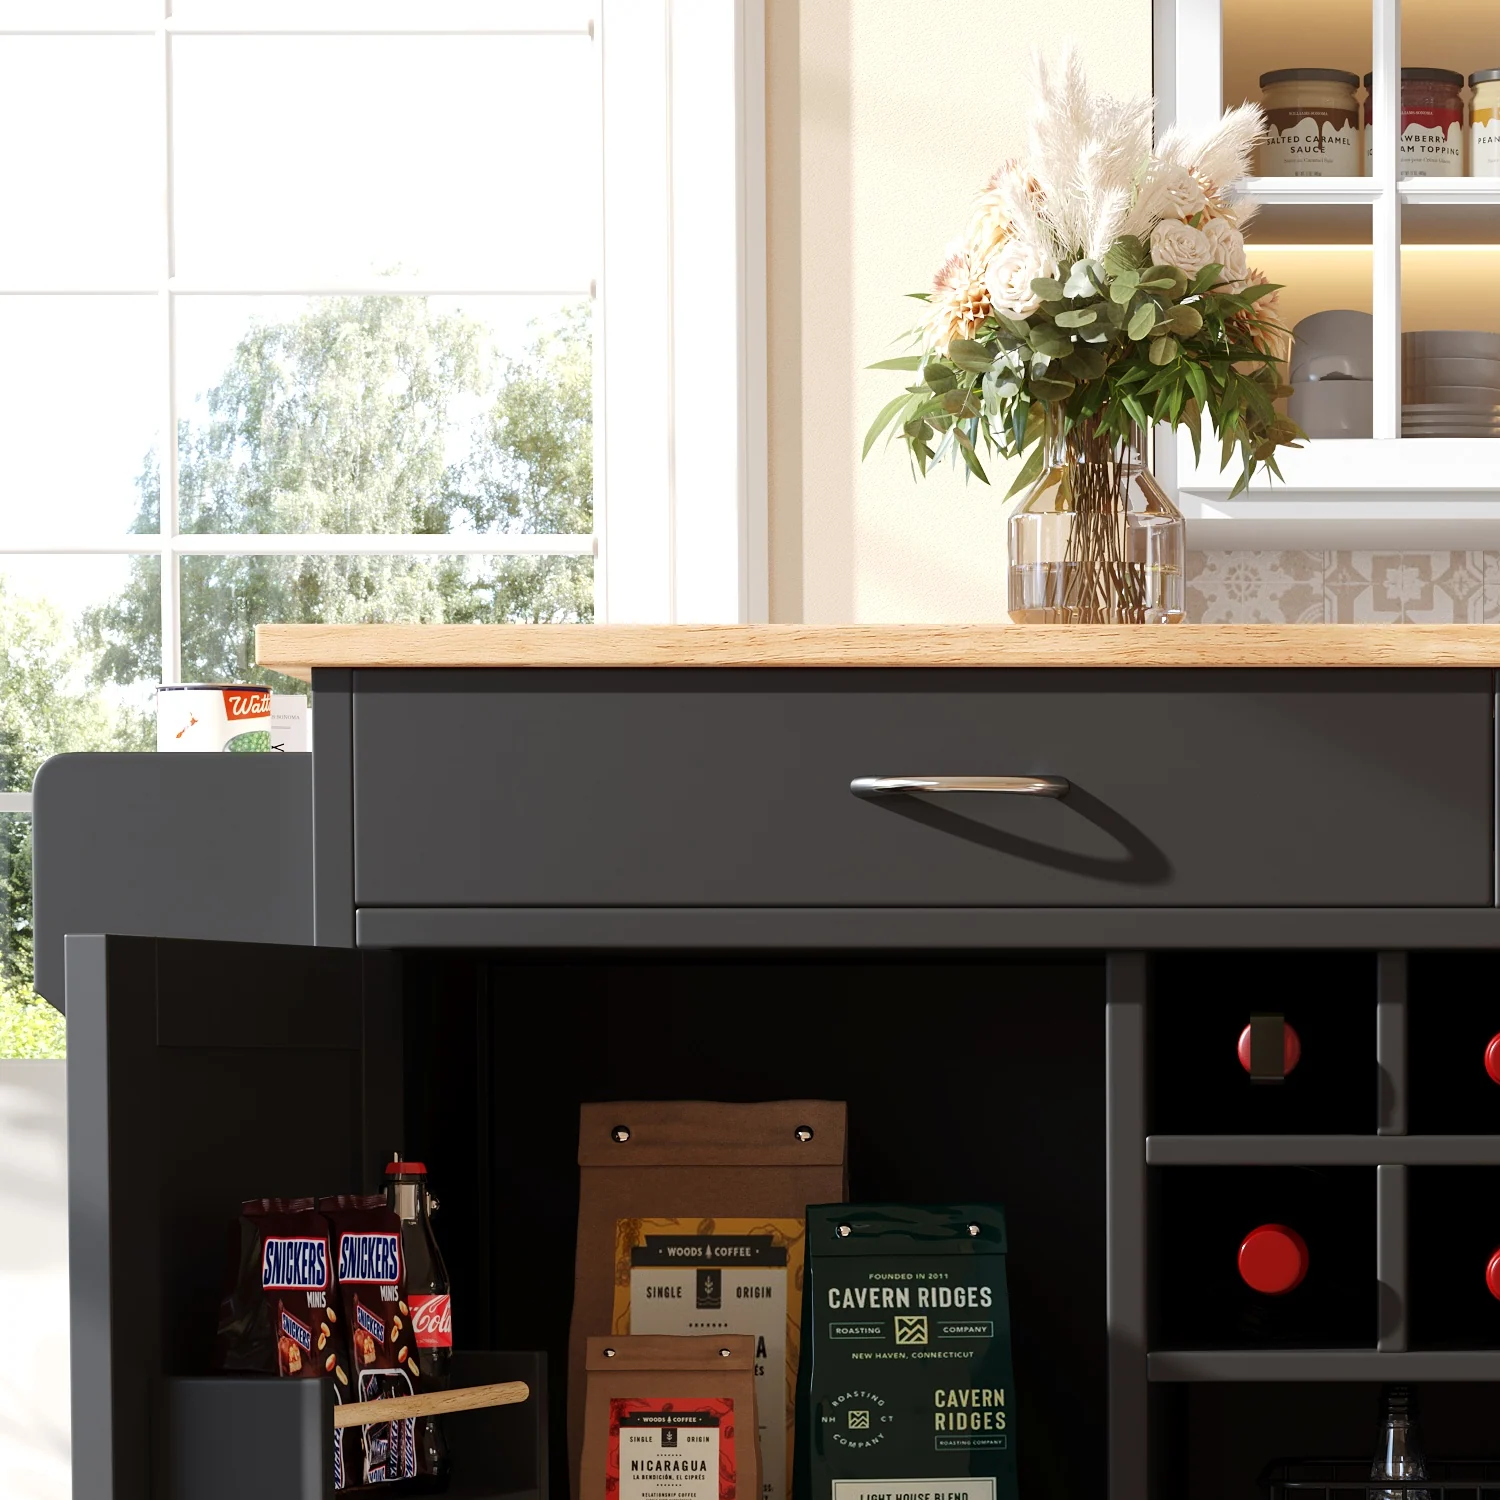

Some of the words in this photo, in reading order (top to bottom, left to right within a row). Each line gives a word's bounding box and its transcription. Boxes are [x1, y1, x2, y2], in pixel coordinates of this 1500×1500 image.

[1266, 135, 1300, 146] SALTED
[1305, 135, 1351, 146] CARAMEL
[1290, 146, 1326, 154] SAUCE
[1420, 145, 1460, 156] TOPPING
[339, 1236, 398, 1281] SNICKERS
[667, 1247, 703, 1257] WOODS
[714, 1247, 752, 1257] COFFEE
[263, 1240, 327, 1288] SNICKERS
[928, 1272, 949, 1280] 2011
[306, 1291, 327, 1309] MINIS
[380, 1284, 400, 1302] MINIS
[646, 1286, 683, 1299] SINGLE
[736, 1286, 772, 1299] ORIGIN
[828, 1287, 910, 1309] CAVERN
[918, 1286, 993, 1308] RIDGES
[281, 1311, 312, 1351] SNICKERS
[356, 1304, 385, 1344] SNICKERS
[942, 1326, 988, 1334] COMPANY
[851, 1352, 872, 1360] NEW
[875, 1352, 909, 1360] HAVEN,
[911, 1351, 974, 1359] CONNECTICUT
[831, 1390, 885, 1407] ROASTING
[934, 1388, 1005, 1408] CAVERN
[934, 1411, 1006, 1431] RIDGES
[832, 1432, 885, 1448] COMPANY
[631, 1460, 707, 1472] NICARAGUA
